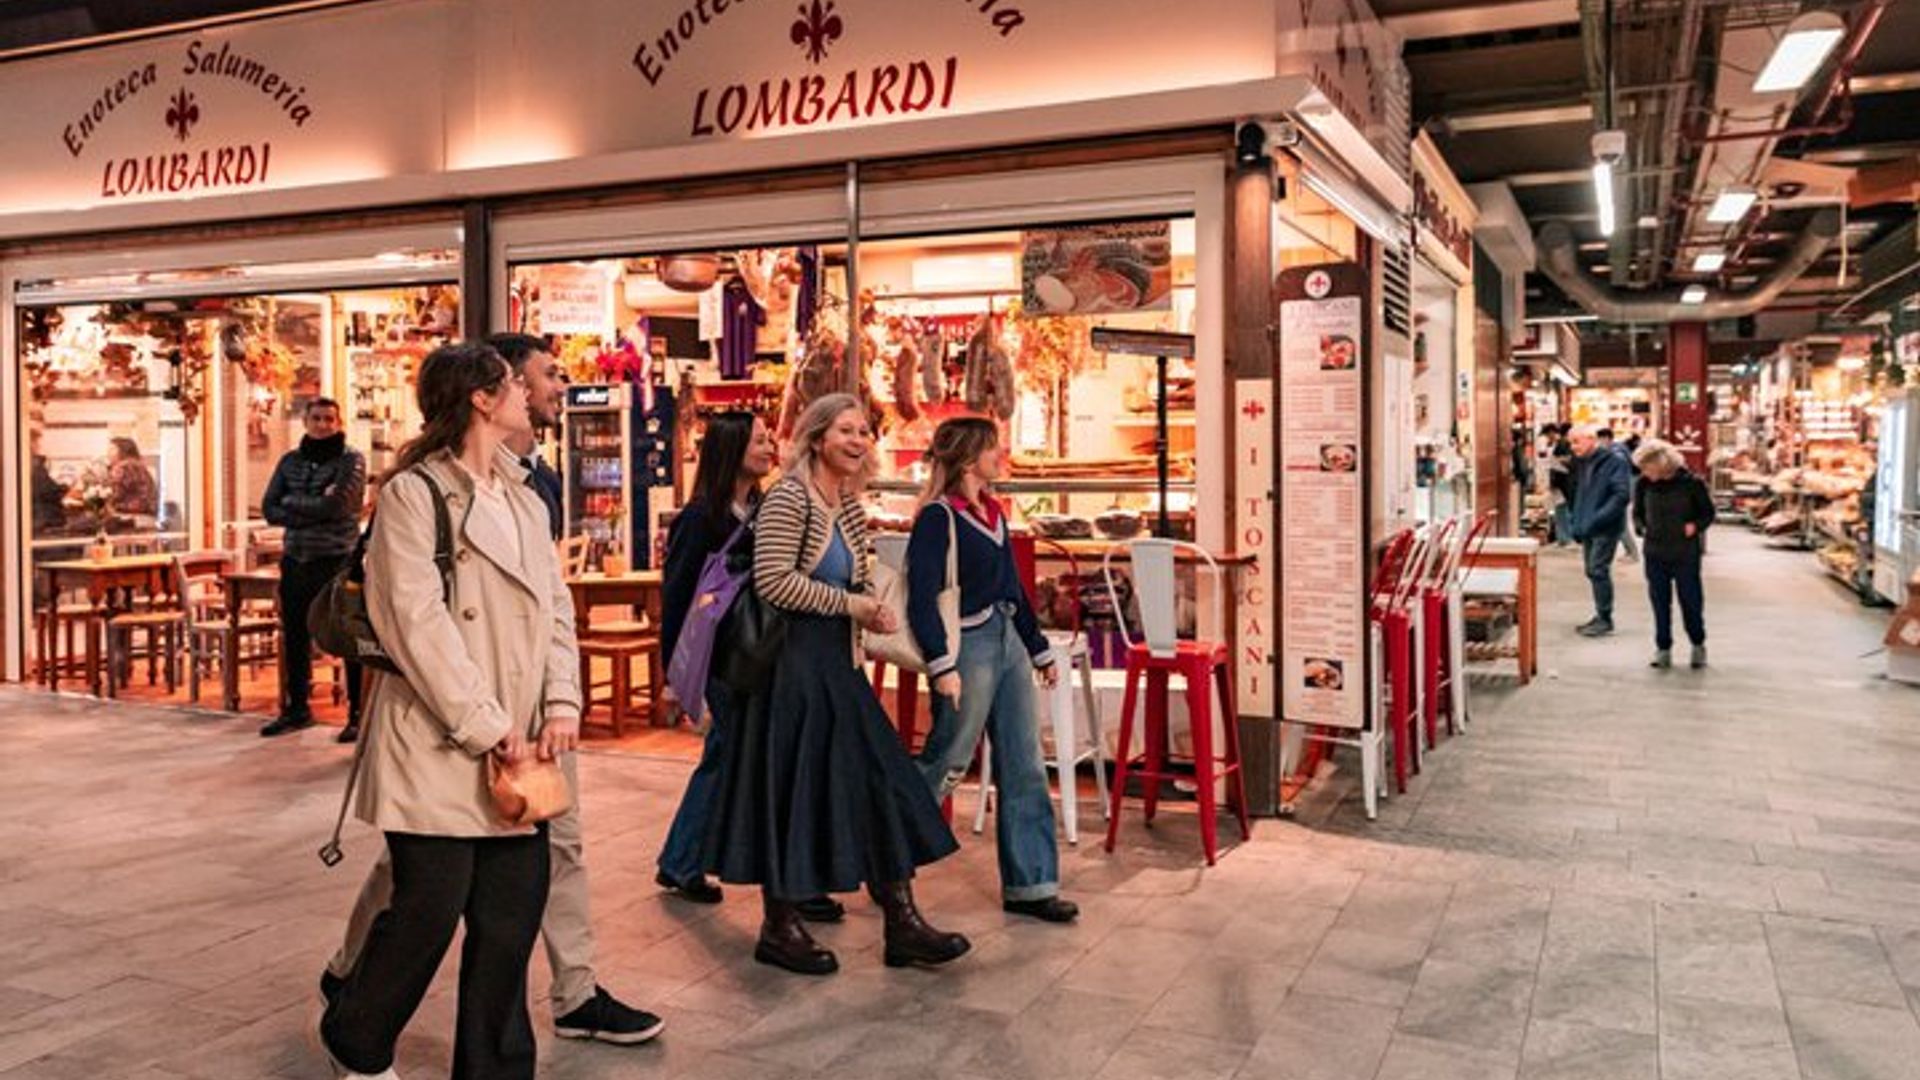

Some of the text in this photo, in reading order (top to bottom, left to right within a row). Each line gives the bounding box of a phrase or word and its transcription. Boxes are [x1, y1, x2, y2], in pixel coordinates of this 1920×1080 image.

[632, 0, 744, 87] Enote
[62, 39, 312, 158] Enoteca Salumeria
[691, 56, 957, 137] LOMBARDI
[101, 142, 270, 197] LOMBARDI
